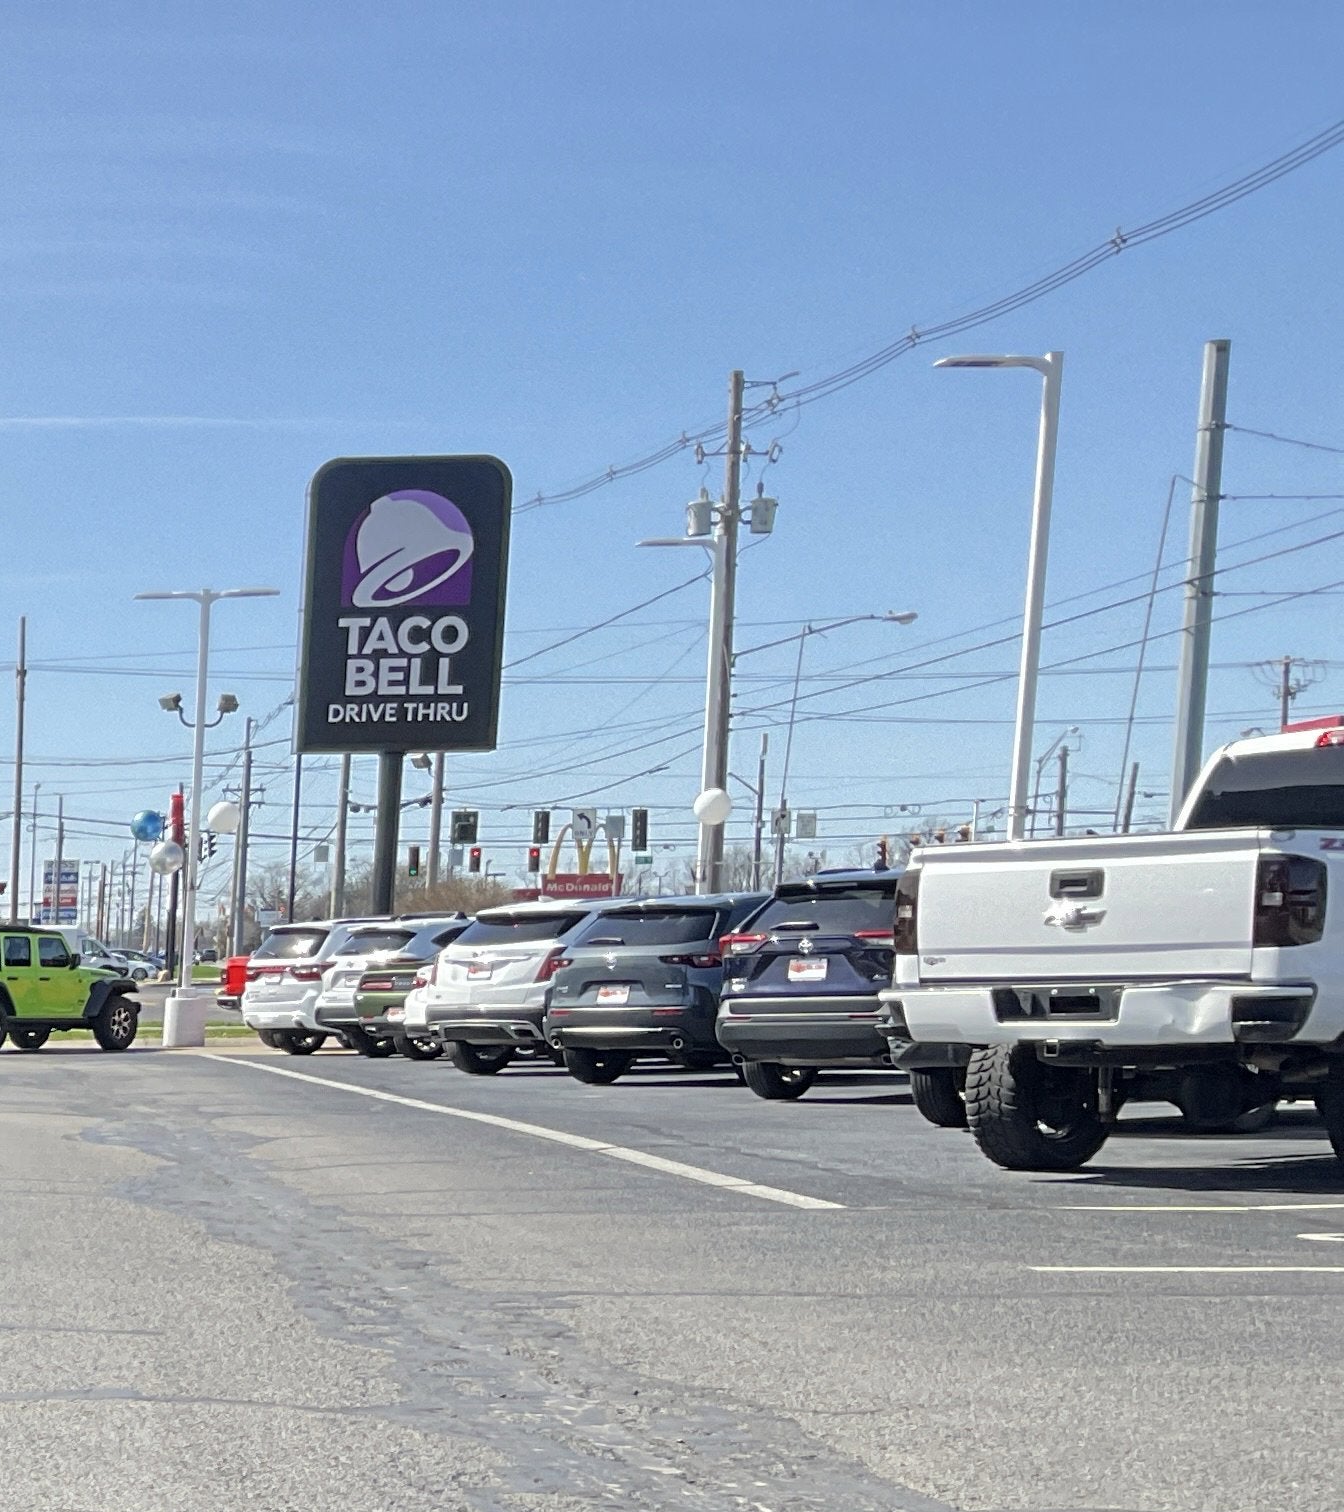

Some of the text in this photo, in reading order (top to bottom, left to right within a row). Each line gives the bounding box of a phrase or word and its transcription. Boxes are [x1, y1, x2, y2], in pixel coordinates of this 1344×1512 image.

[338, 615, 469, 655] TACO
[344, 657, 464, 696] BELL
[327, 702, 469, 723] DRIVE THRU
